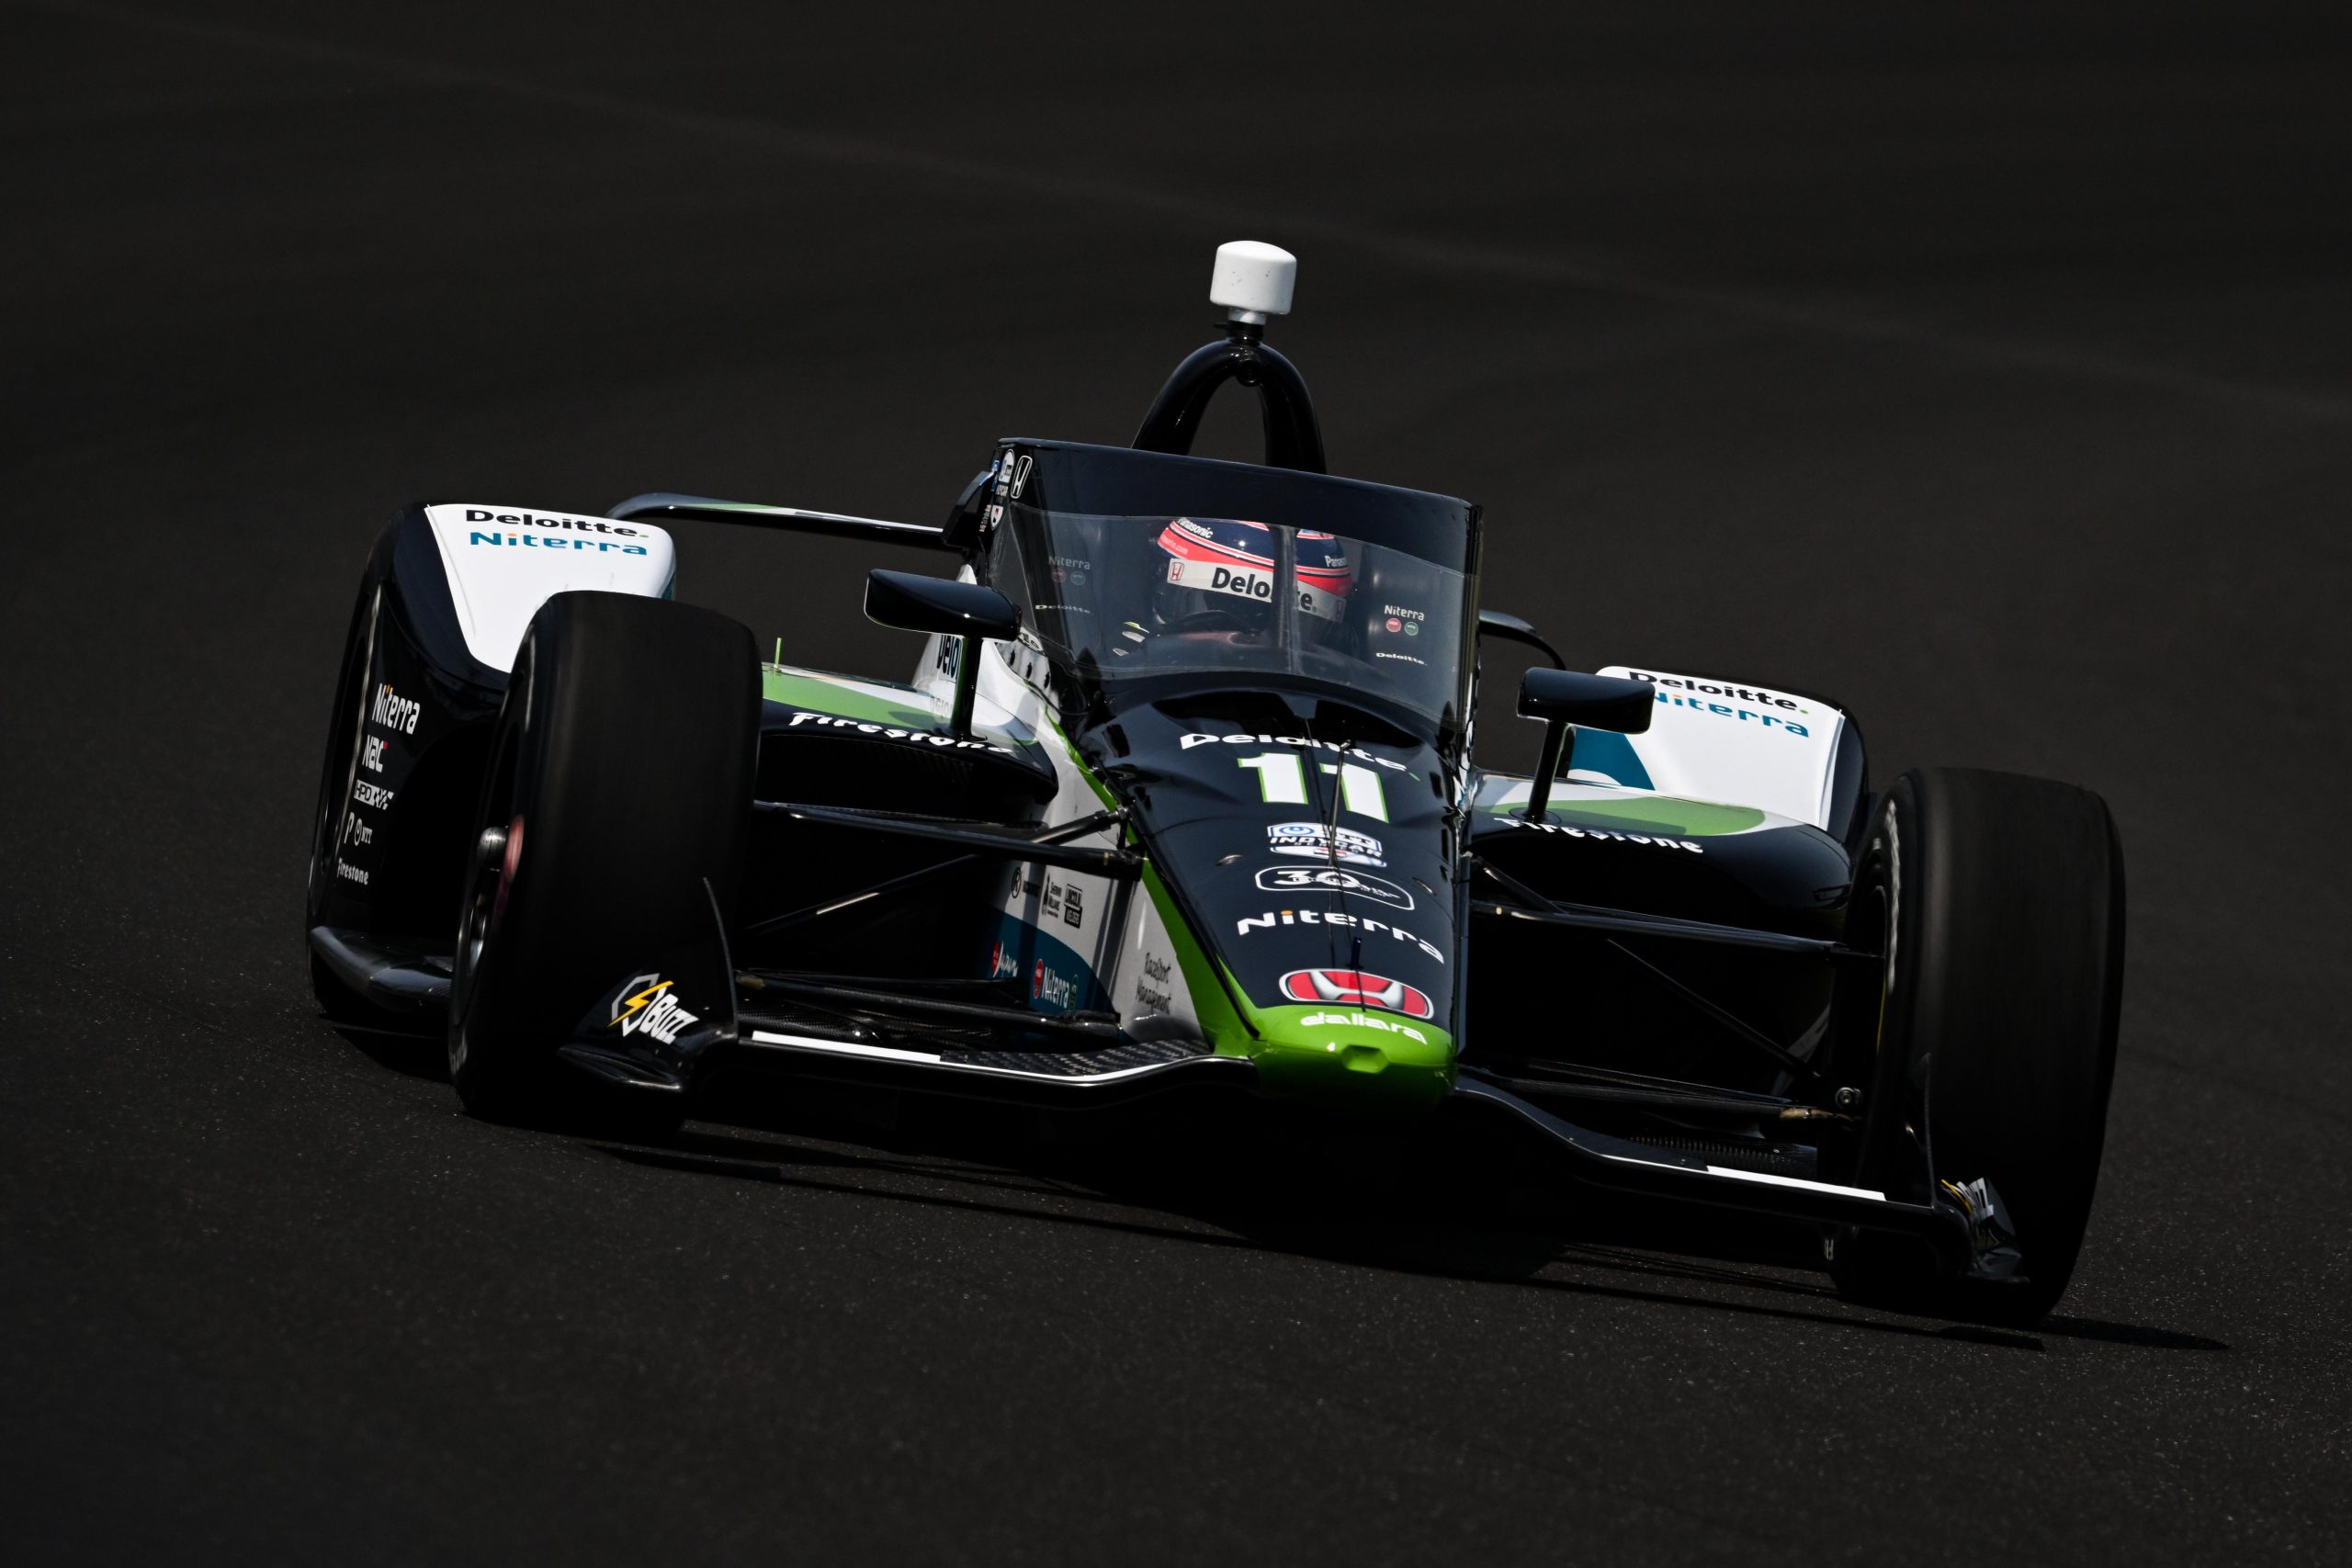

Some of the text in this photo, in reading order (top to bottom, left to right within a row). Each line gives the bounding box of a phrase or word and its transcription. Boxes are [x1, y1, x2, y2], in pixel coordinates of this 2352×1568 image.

[470, 532, 647, 555] Niterra
[1048, 555, 1091, 570] Niterra
[1384, 604, 1425, 622] Niterra
[371, 682, 421, 736] Niterra
[788, 712, 1012, 753] Firestone
[1237, 752, 1389, 824] 11
[1493, 817, 1704, 854] Firestone
[336, 857, 369, 886] Firestone
[1237, 908, 1445, 964] Niterra
[1042, 965, 1070, 1010] Niterra
[1300, 1011, 1428, 1045] dallara
